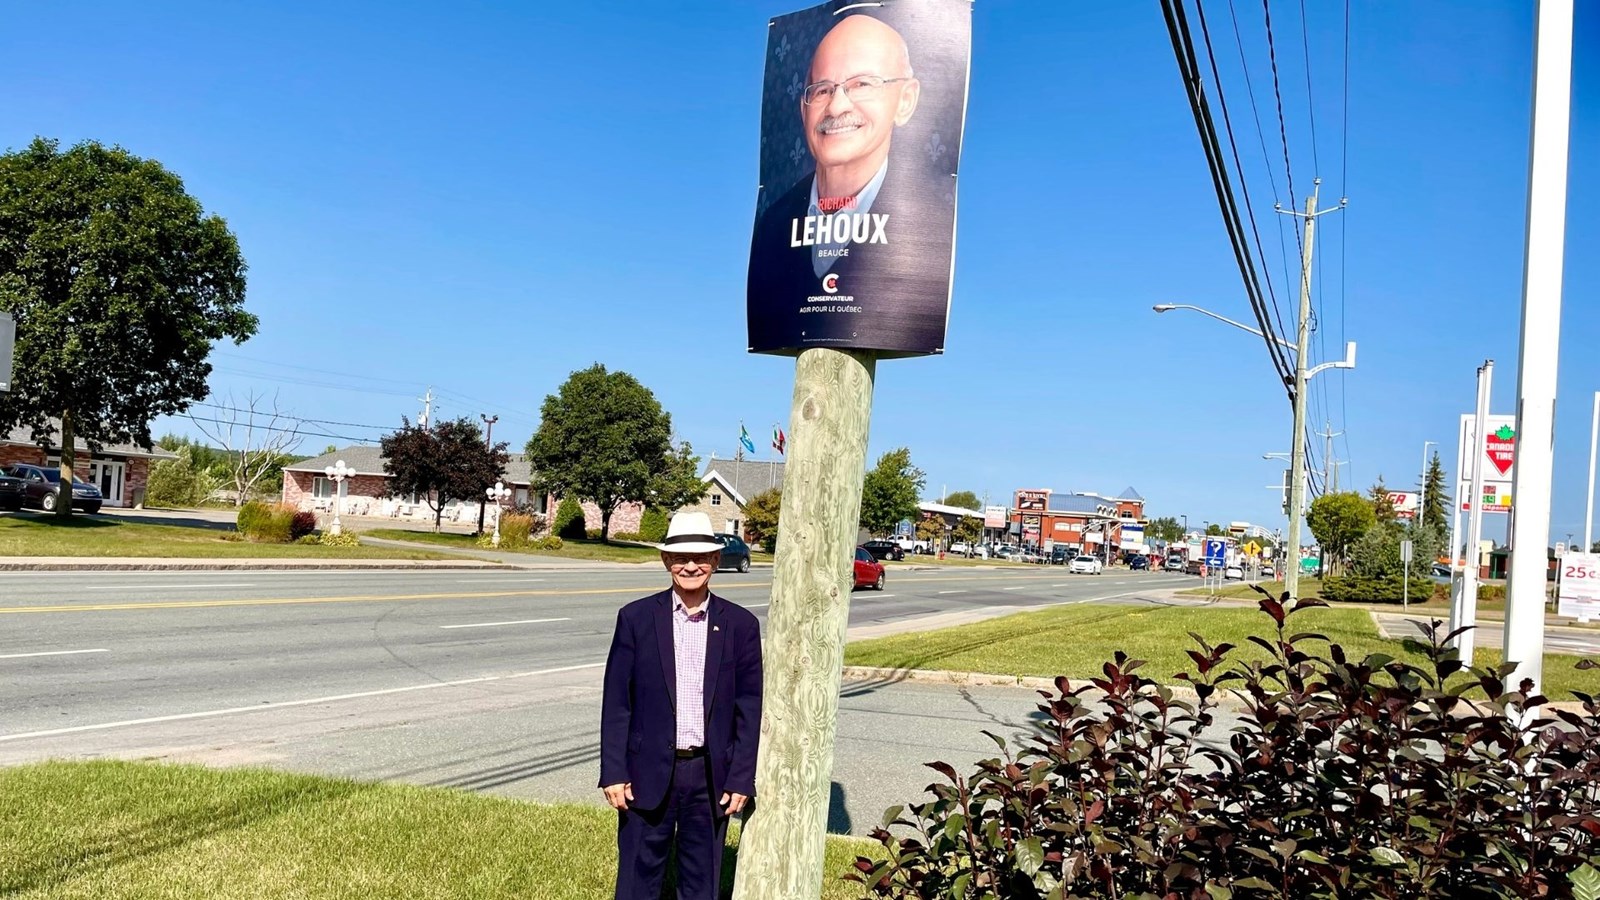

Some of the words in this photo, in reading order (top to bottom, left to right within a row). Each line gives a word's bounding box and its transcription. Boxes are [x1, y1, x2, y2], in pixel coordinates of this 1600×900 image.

[819, 197, 857, 210] RICHARD
[791, 213, 889, 247] LEHOUX
[818, 249, 849, 257] BEAUCE
[807, 295, 854, 303] CONSERVATEUR
[799, 306, 812, 314] AGIR
[811, 305, 828, 313] POUR
[828, 305, 836, 313] LE
[836, 304, 863, 313] QUÉBEC
[1495, 452, 1513, 460] TIRE
